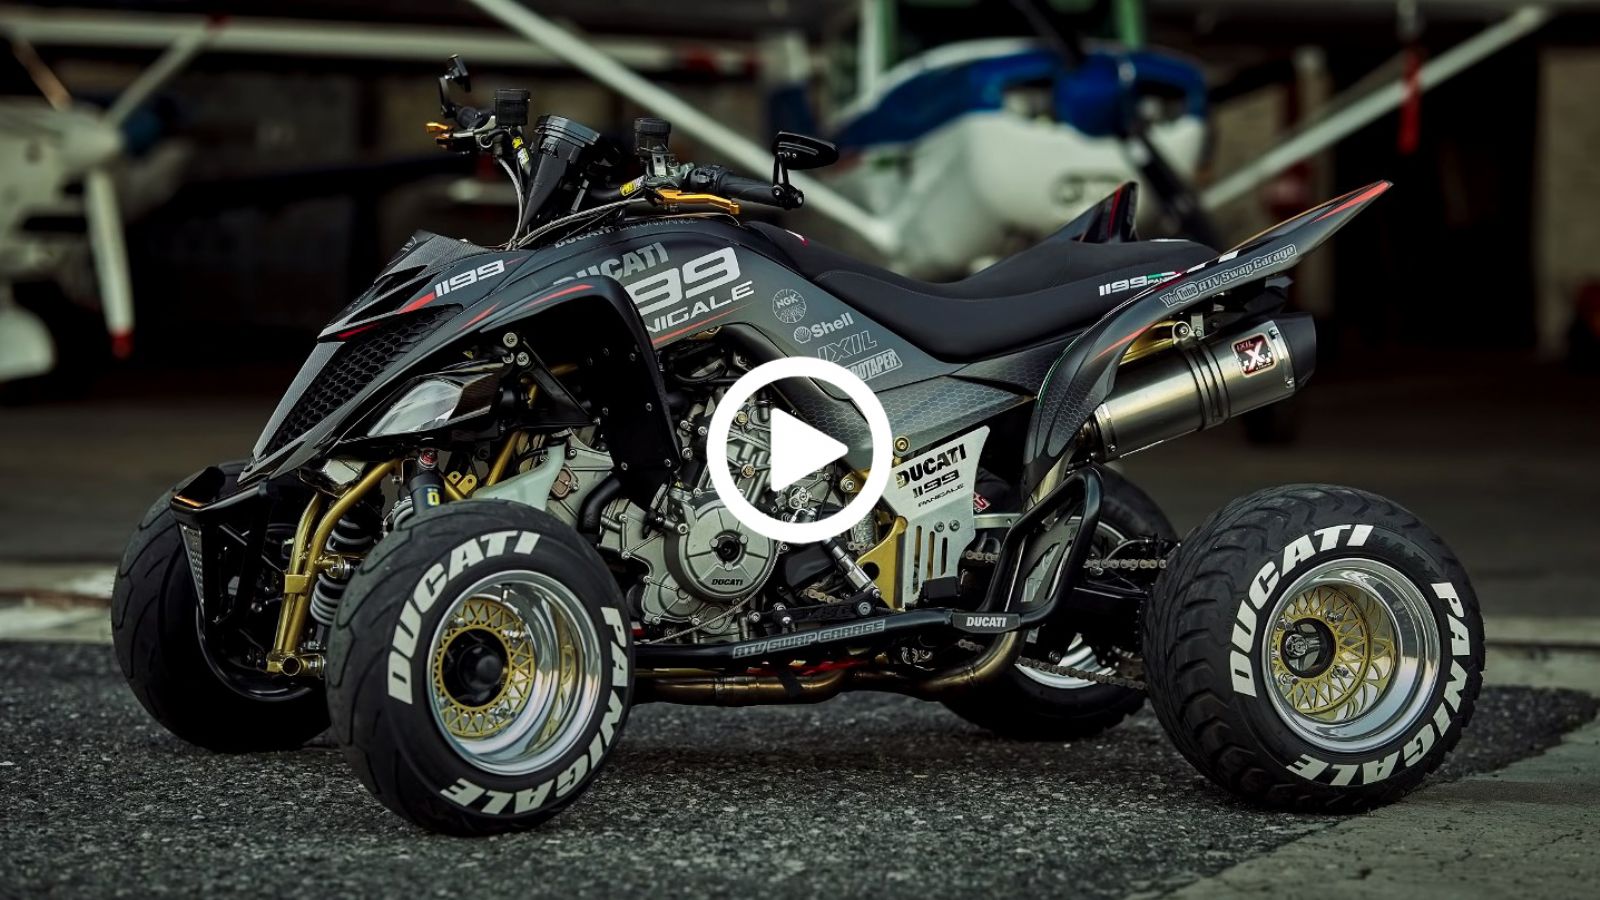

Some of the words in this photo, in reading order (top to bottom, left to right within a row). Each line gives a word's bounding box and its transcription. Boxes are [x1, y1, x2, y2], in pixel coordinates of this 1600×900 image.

[434, 259, 505, 298] 1199
[553, 241, 669, 290] CATI
[1221, 263, 1254, 282] Swap
[1253, 245, 1295, 269] Garage
[624, 246, 741, 316] 99
[1099, 275, 1148, 297] 1199
[776, 293, 799, 309] NGK
[811, 312, 854, 338] Shell
[817, 330, 878, 363] IXIL
[851, 353, 898, 379] ROTAPER
[896, 443, 967, 489] DUCATI
[913, 469, 960, 498] 1199
[918, 483, 965, 508] PANIGALE
[711, 577, 744, 587] DUCATI
[387, 530, 541, 705] DUCATI
[966, 616, 1007, 628] DUCATI
[1229, 524, 1374, 698] DUCATI
[767, 632, 818, 653] SWAP
[818, 619, 886, 642] GARAGE
[1285, 581, 1471, 786] PANIGALE
[439, 606, 629, 815] PANIGALE
